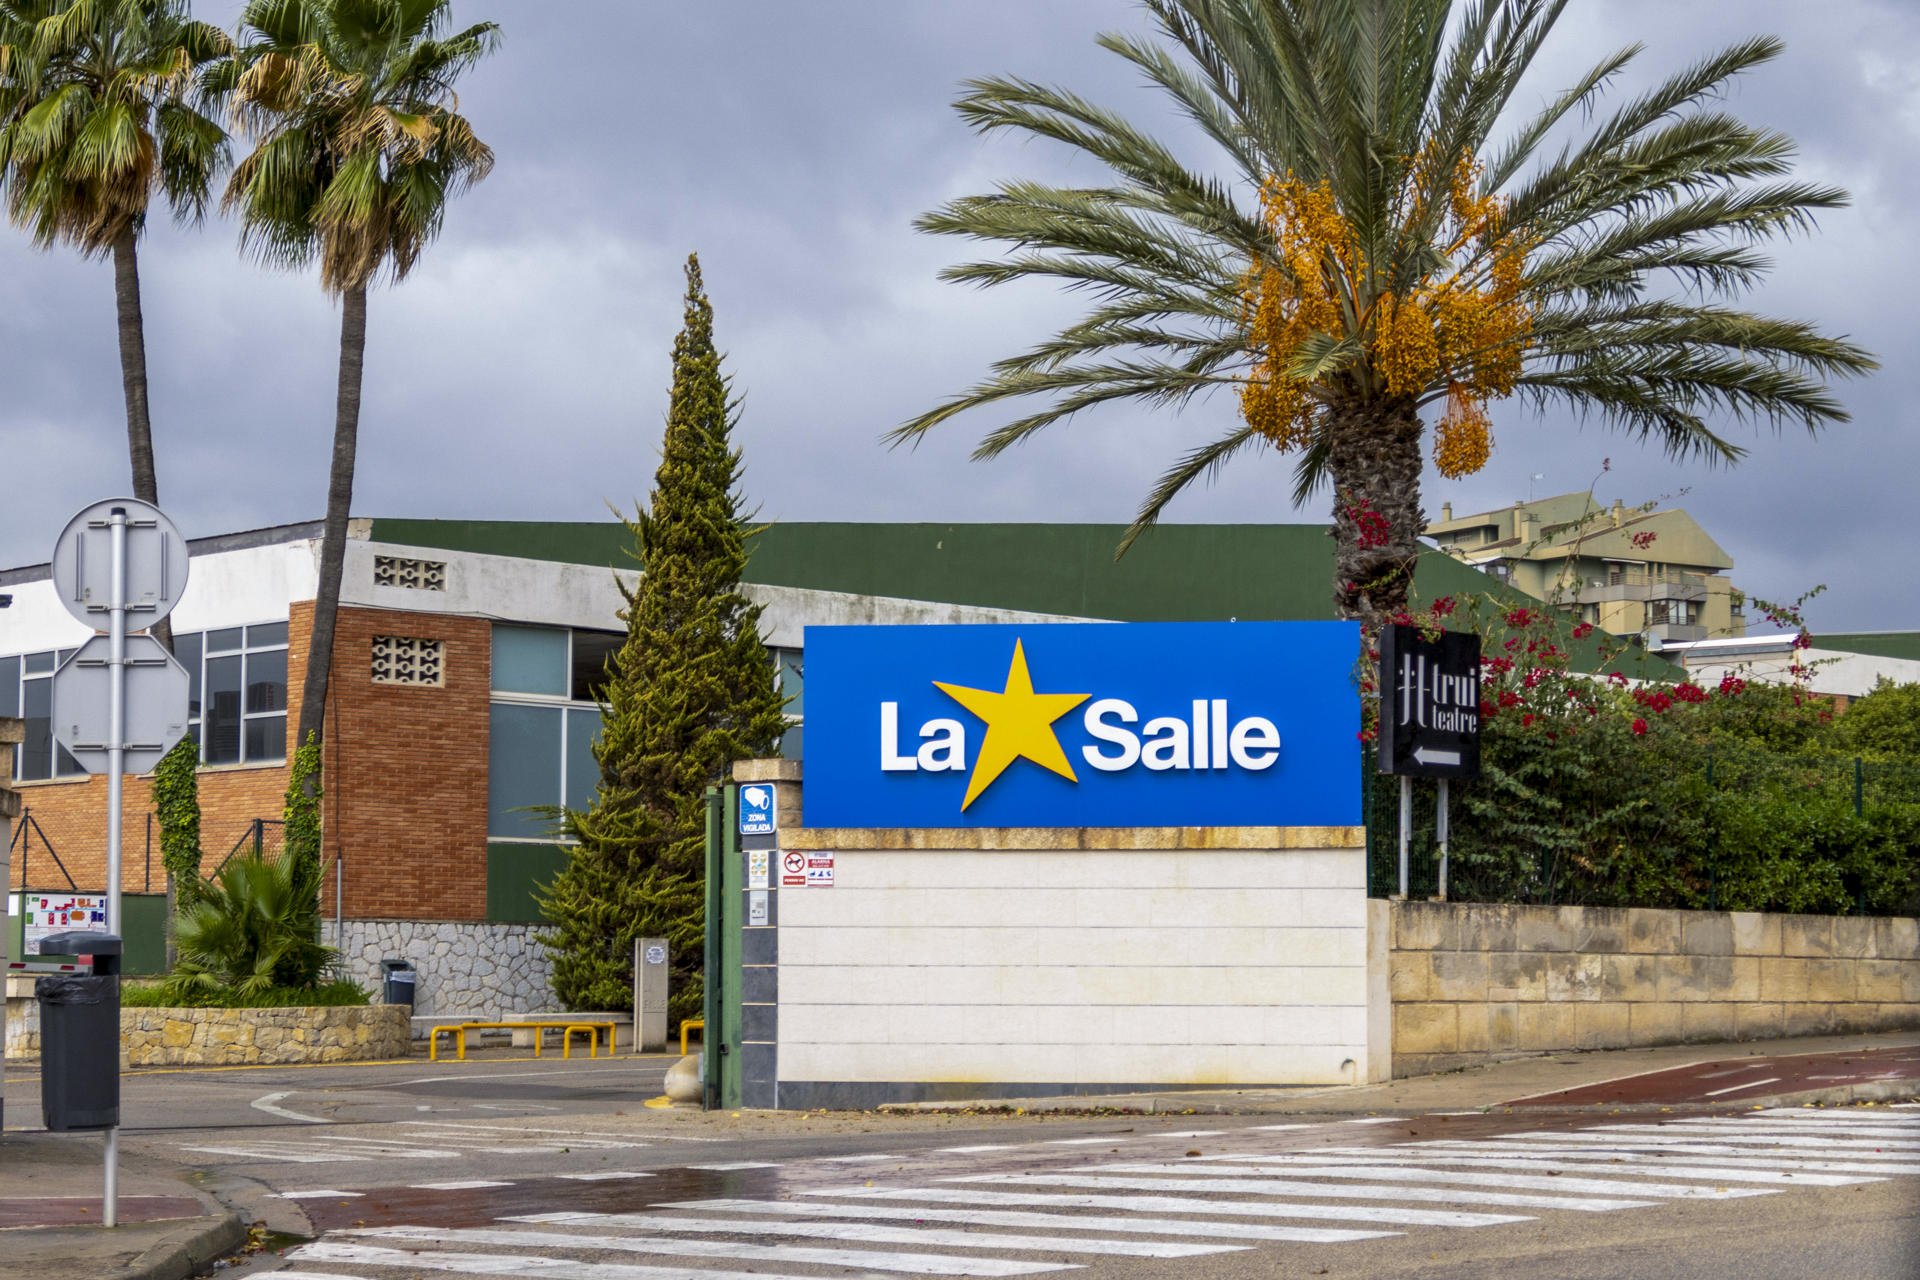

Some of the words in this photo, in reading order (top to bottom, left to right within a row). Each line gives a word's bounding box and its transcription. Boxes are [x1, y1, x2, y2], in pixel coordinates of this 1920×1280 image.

[1433, 664, 1476, 707] trui
[1432, 705, 1477, 733] teatre
[880, 701, 966, 771] La
[1082, 698, 1281, 771] Salle
[743, 824, 771, 832] VIGILADA
[748, 814, 766, 822] ZONA
